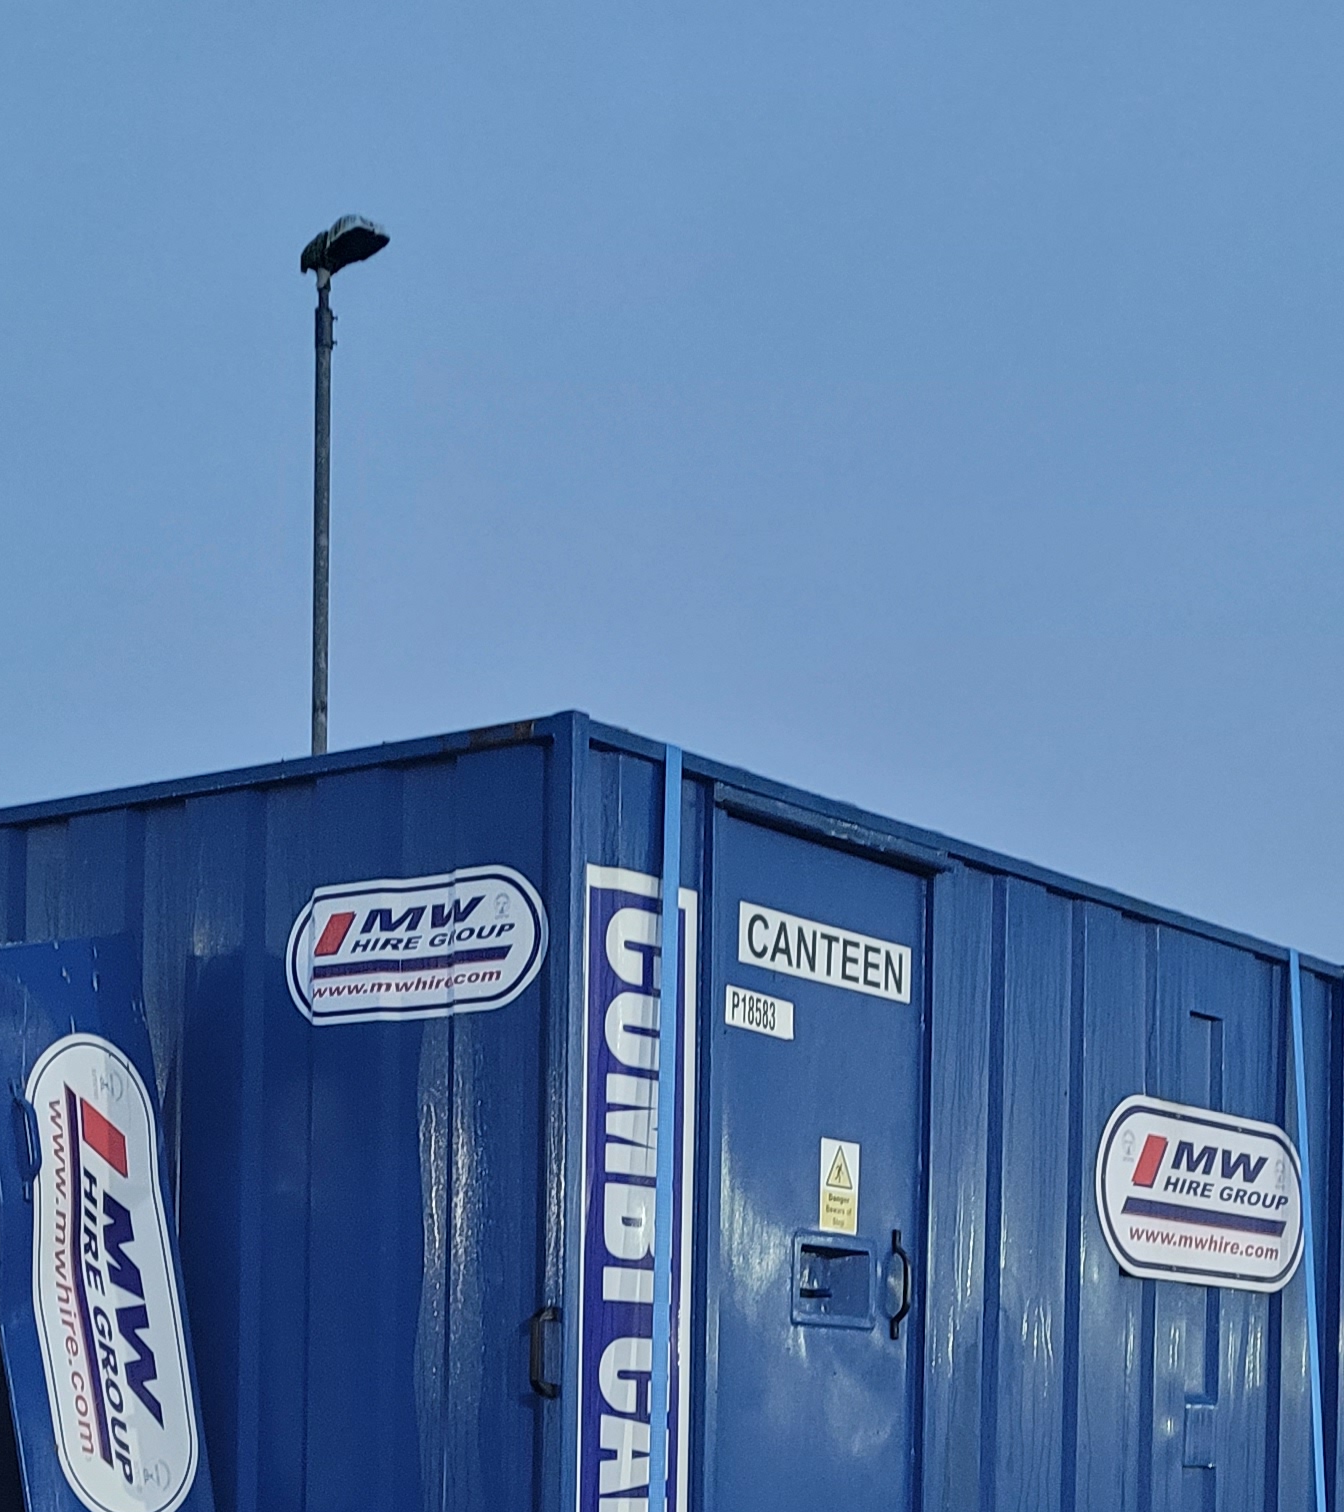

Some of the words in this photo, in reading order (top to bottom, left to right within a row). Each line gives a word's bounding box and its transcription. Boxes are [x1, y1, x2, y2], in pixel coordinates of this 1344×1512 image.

[359, 895, 486, 935] MW
[350, 934, 423, 954] HIRE
[428, 922, 516, 949] GROUP
[747, 913, 903, 995] CANTEEN
[312, 969, 502, 999] www.mwhirecom
[731, 990, 776, 1032] P18583
[602, 906, 668, 1301] COMBI
[1171, 1140, 1269, 1184] MW
[1163, 1175, 1215, 1199] HIRE
[1219, 1186, 1289, 1211] GROUP
[82, 1165, 105, 1299] HIRE
[1129, 1225, 1280, 1262] www.mwhire.com
[48, 1099, 94, 1456] www.mwhire.com
[103, 1188, 165, 1431] MW
[89, 1304, 136, 1486] GROUP
